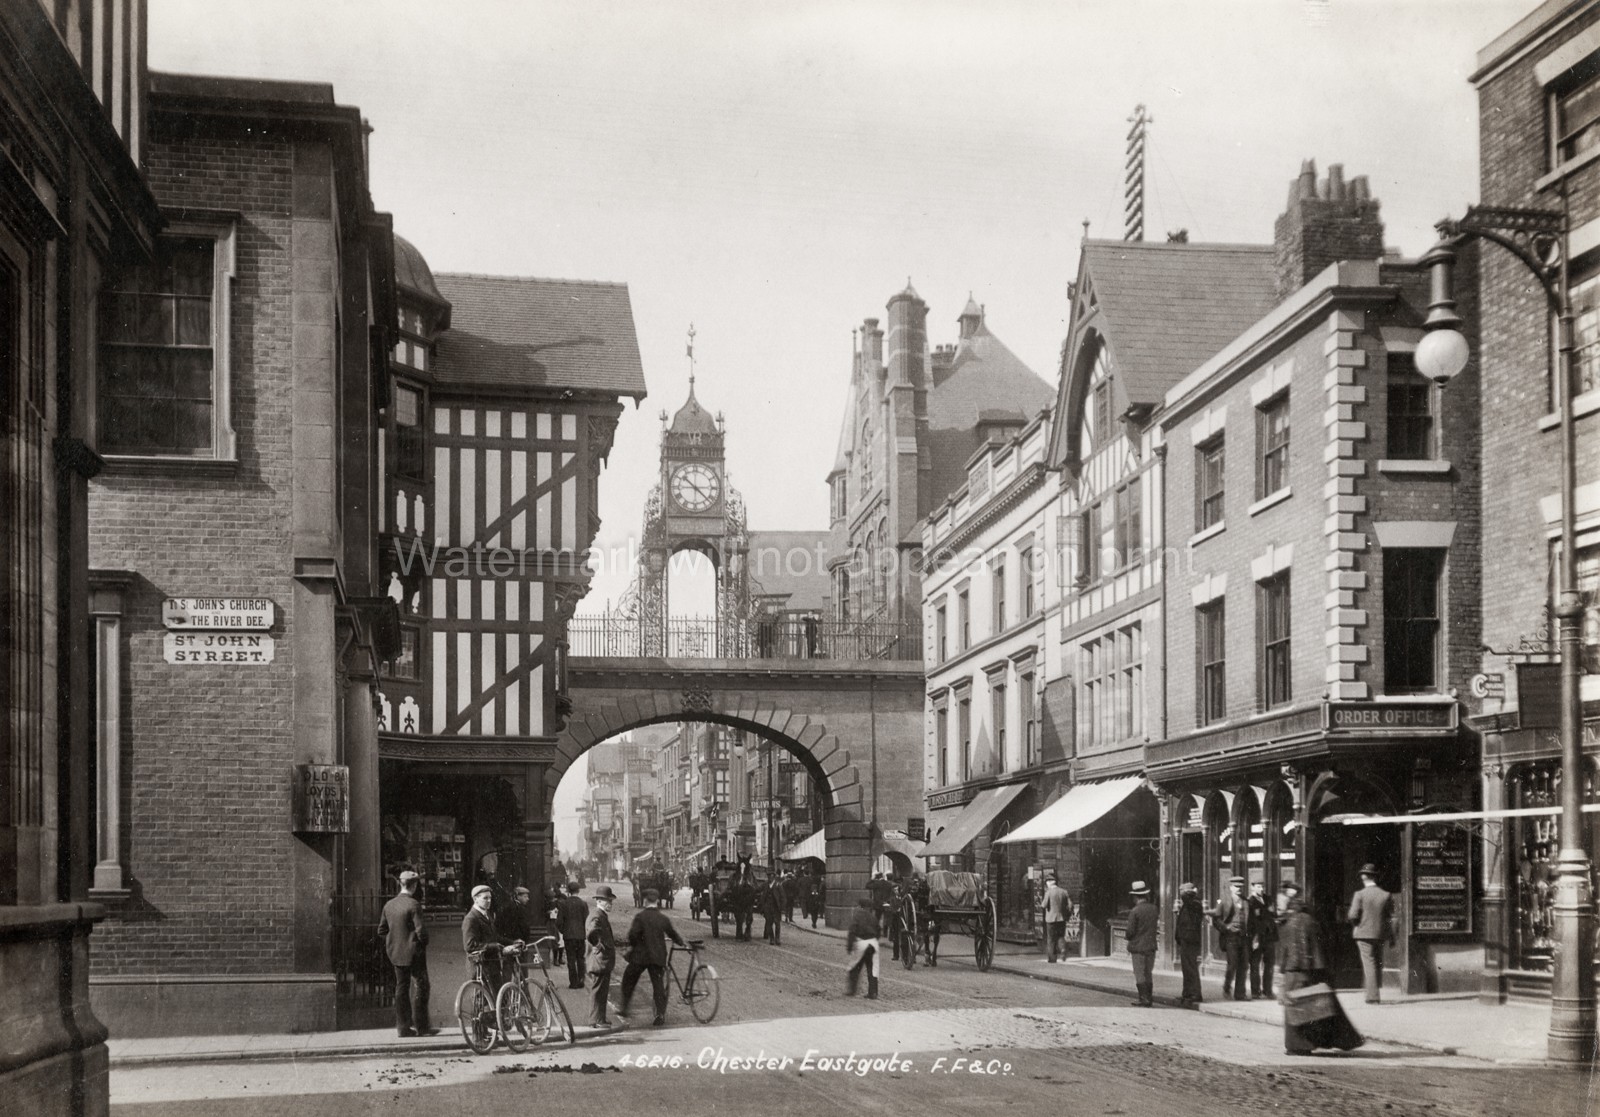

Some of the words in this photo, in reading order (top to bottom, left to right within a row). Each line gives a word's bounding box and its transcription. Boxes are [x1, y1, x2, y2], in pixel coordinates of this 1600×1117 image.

[193, 599, 225, 610] JOHN'S
[229, 599, 267, 611] CHURCH
[190, 615, 210, 626] THE
[213, 615, 242, 626] RIVER
[204, 635, 261, 647] JOHN
[1334, 709, 1380, 724] ORDER
[1385, 708, 1434, 724] OFFICE
[304, 771, 329, 781] OLD
[751, 801, 780, 809] OLIVRS
